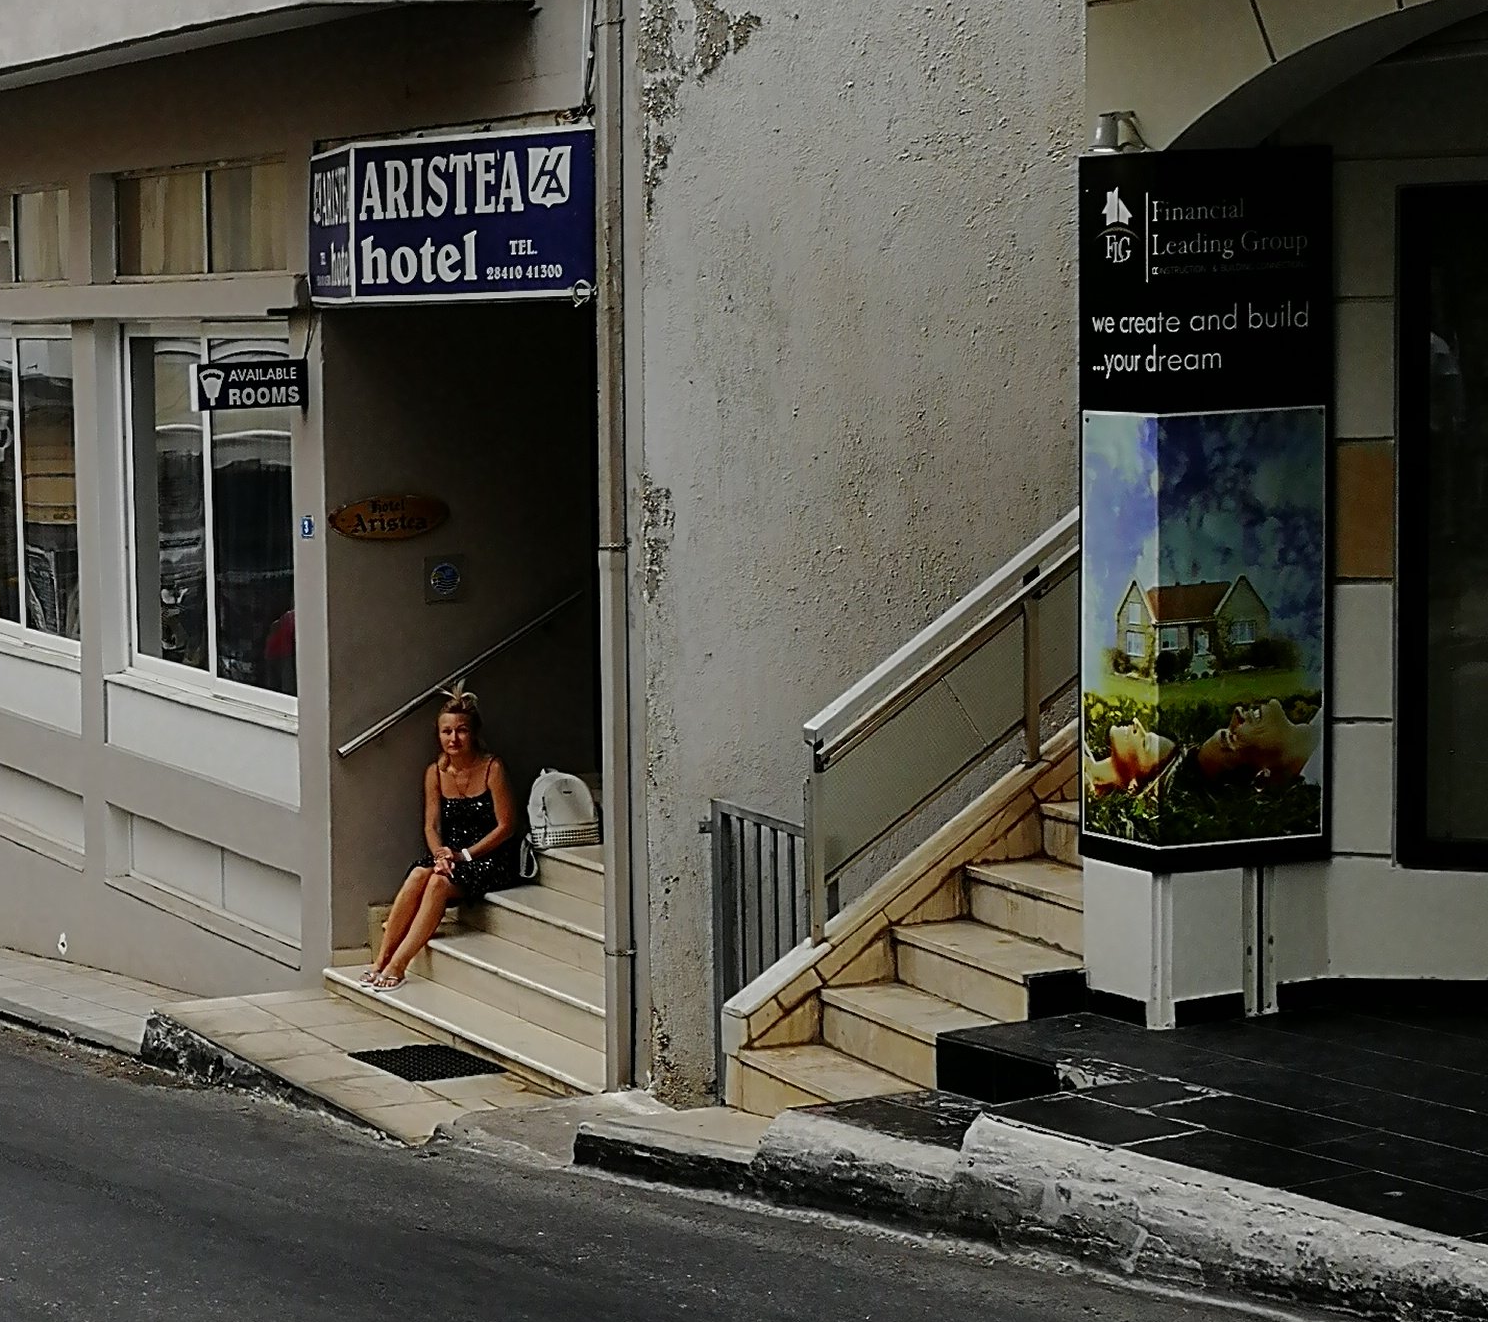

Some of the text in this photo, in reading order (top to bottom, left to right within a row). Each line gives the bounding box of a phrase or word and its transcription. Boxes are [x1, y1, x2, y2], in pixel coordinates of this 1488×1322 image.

[359, 150, 525, 221] ARISTEA
[1151, 197, 1245, 222] Financial
[360, 230, 478, 285] hotel
[509, 239, 538, 255] TEL.
[1151, 229, 1309, 260] Leading Group
[486, 264, 563, 280] 28410 41300
[1092, 300, 1309, 334] we create and build
[1145, 343, 1222, 372] dream
[228, 366, 297, 382] AVAILABLE
[228, 385, 301, 406] ROOMS
